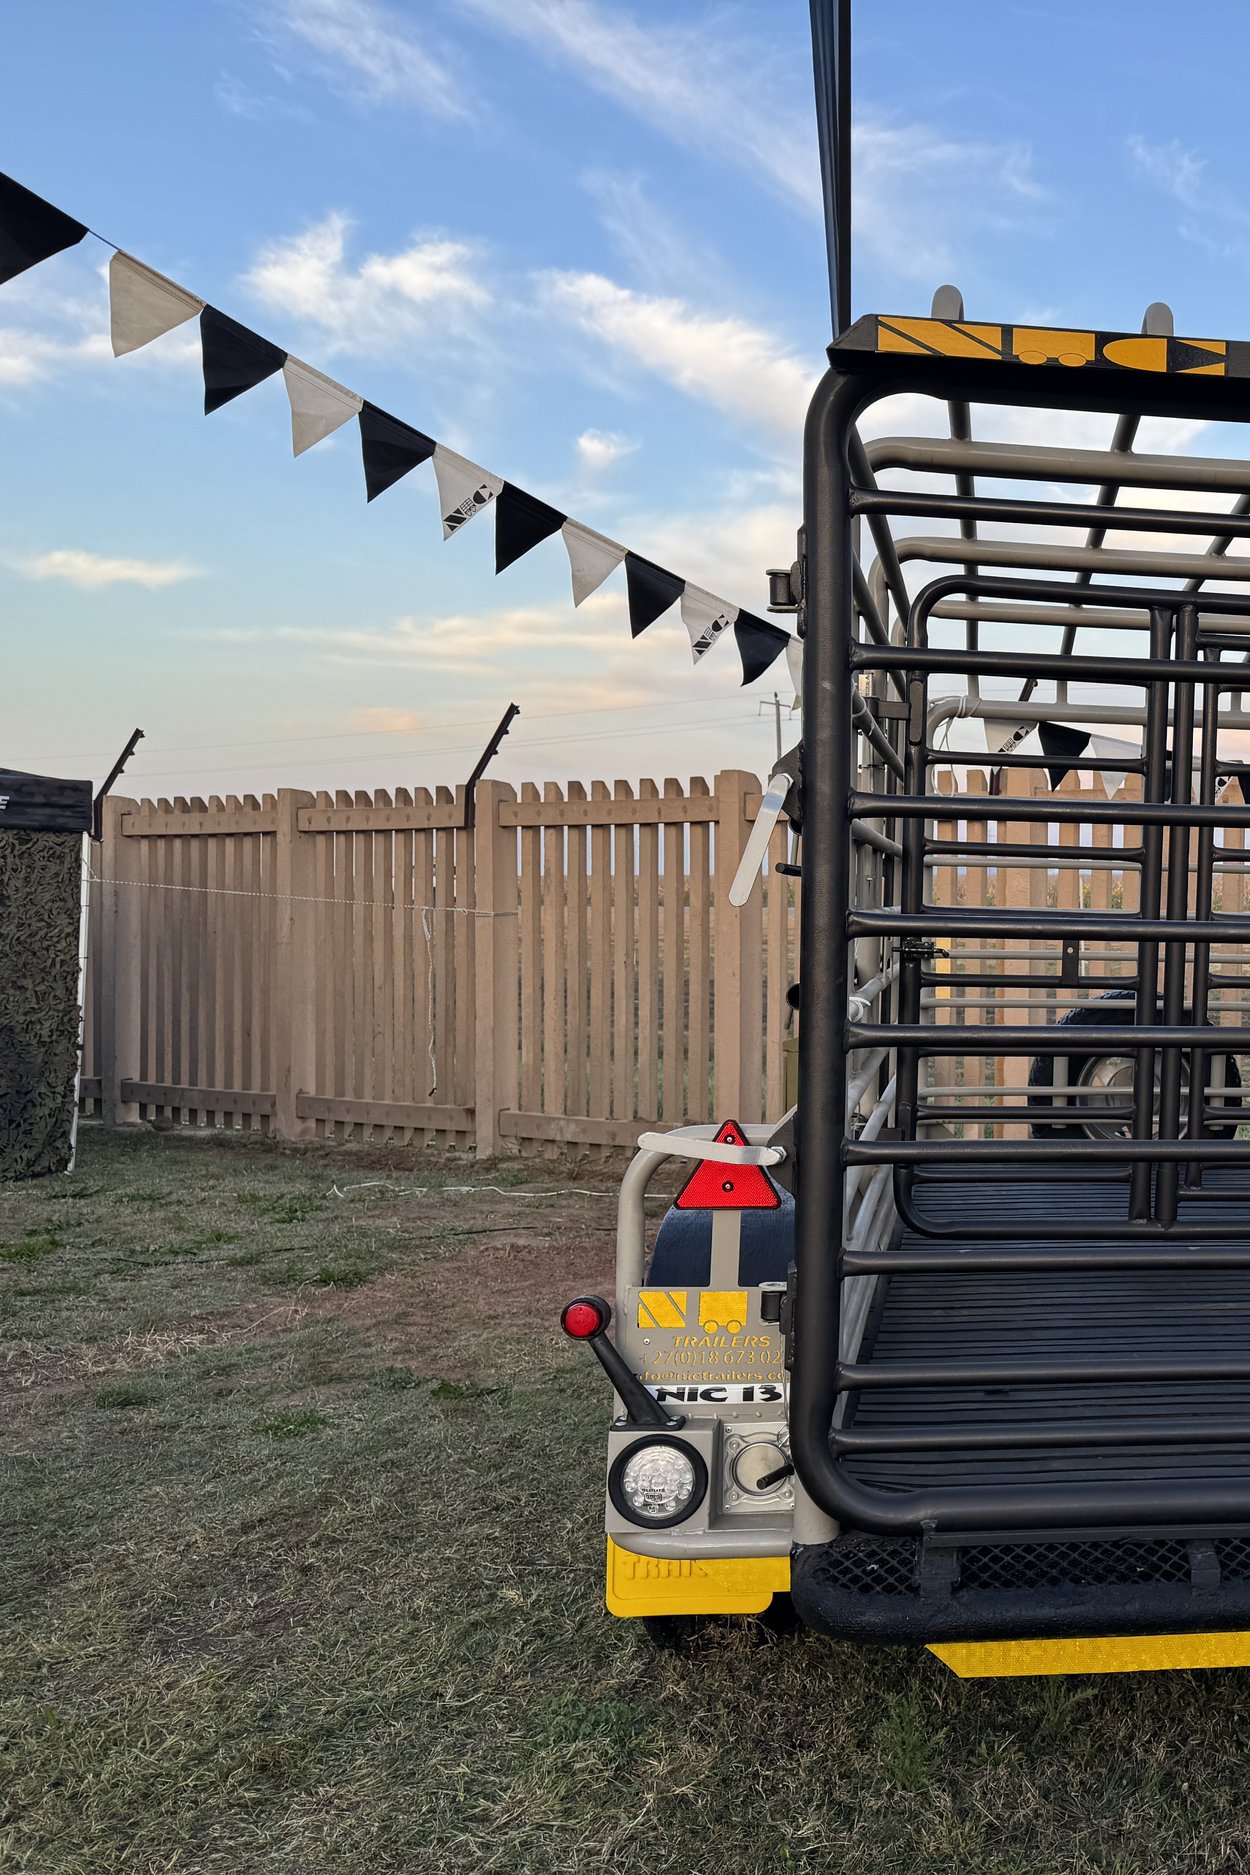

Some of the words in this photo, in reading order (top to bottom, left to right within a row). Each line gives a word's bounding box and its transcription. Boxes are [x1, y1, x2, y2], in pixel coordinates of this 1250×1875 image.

[673, 1335, 771, 1348] TRAILERS
[723, 1351, 755, 1365] 673
[760, 1351, 782, 1365] 02
[656, 1386, 729, 1402] NIC
[742, 1384, 783, 1402] 13
